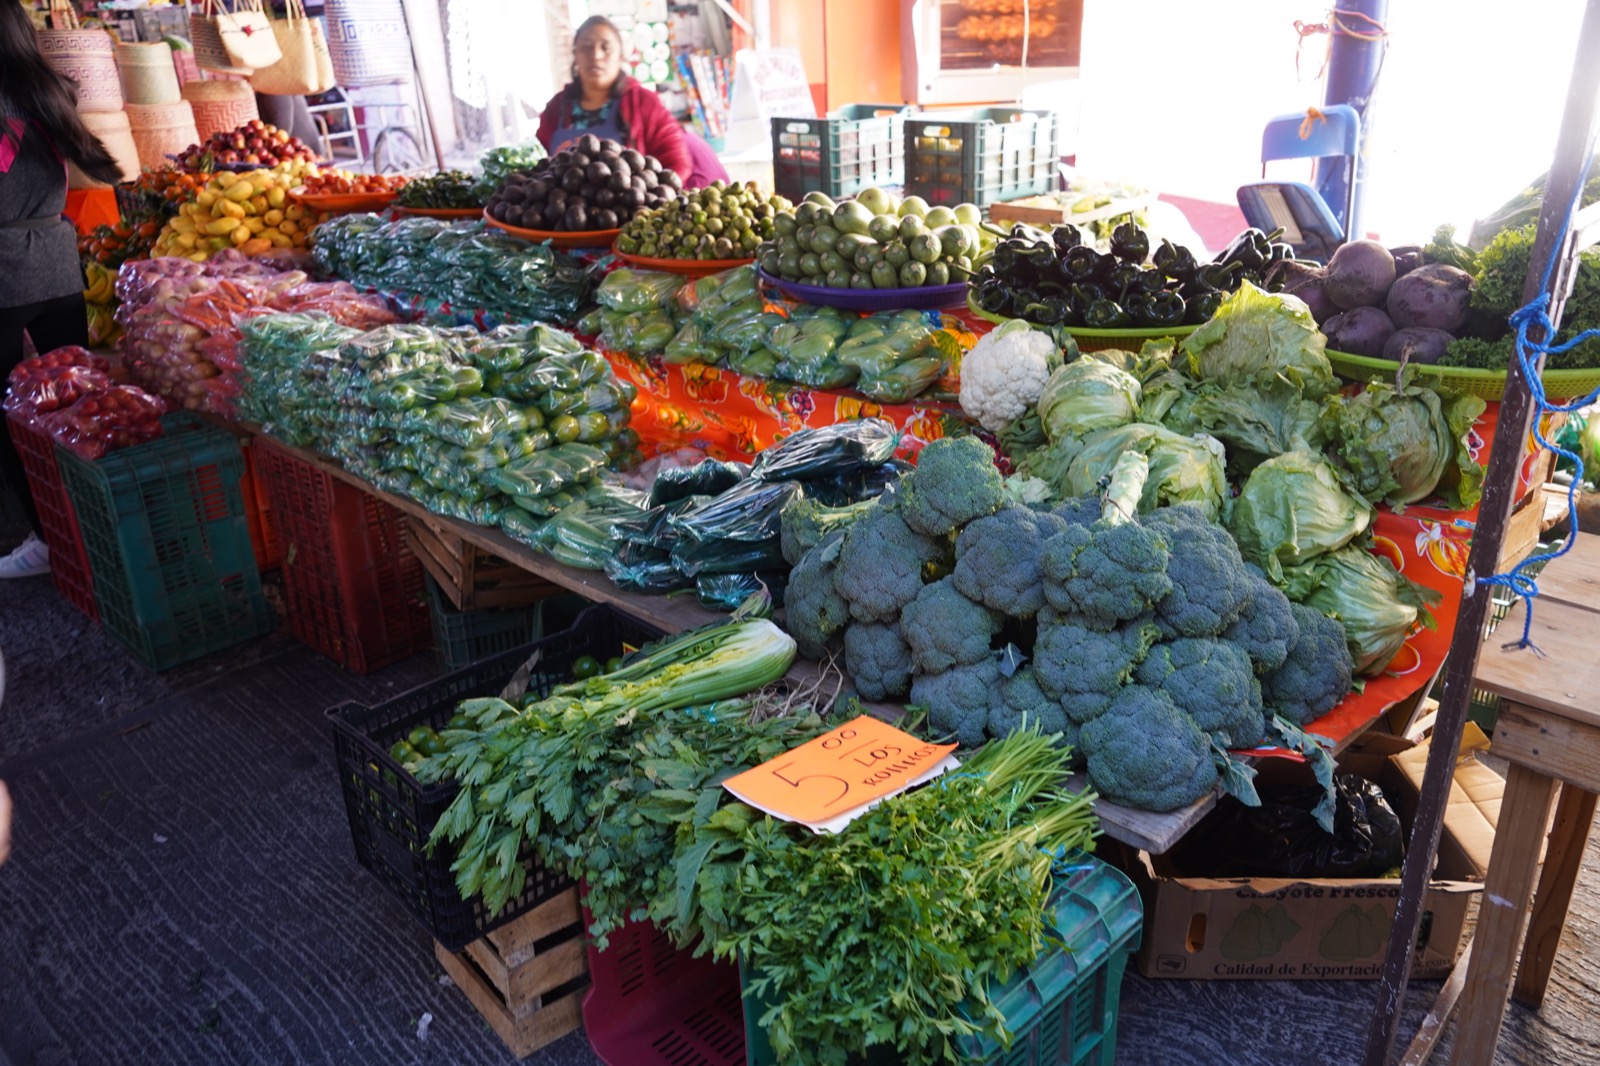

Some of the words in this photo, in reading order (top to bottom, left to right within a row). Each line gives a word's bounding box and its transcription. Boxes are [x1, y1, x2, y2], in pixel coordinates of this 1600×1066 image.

[854, 744, 902, 767] LOS
[772, 761, 849, 808] 5
[822, 729, 857, 750] 00
[1235, 884, 1324, 901] Cyote
[1328, 885, 1399, 899] Fresco
[1213, 962, 1274, 976] Calidad
[1278, 963, 1297, 976] de
[1301, 962, 1384, 978] Exportació
